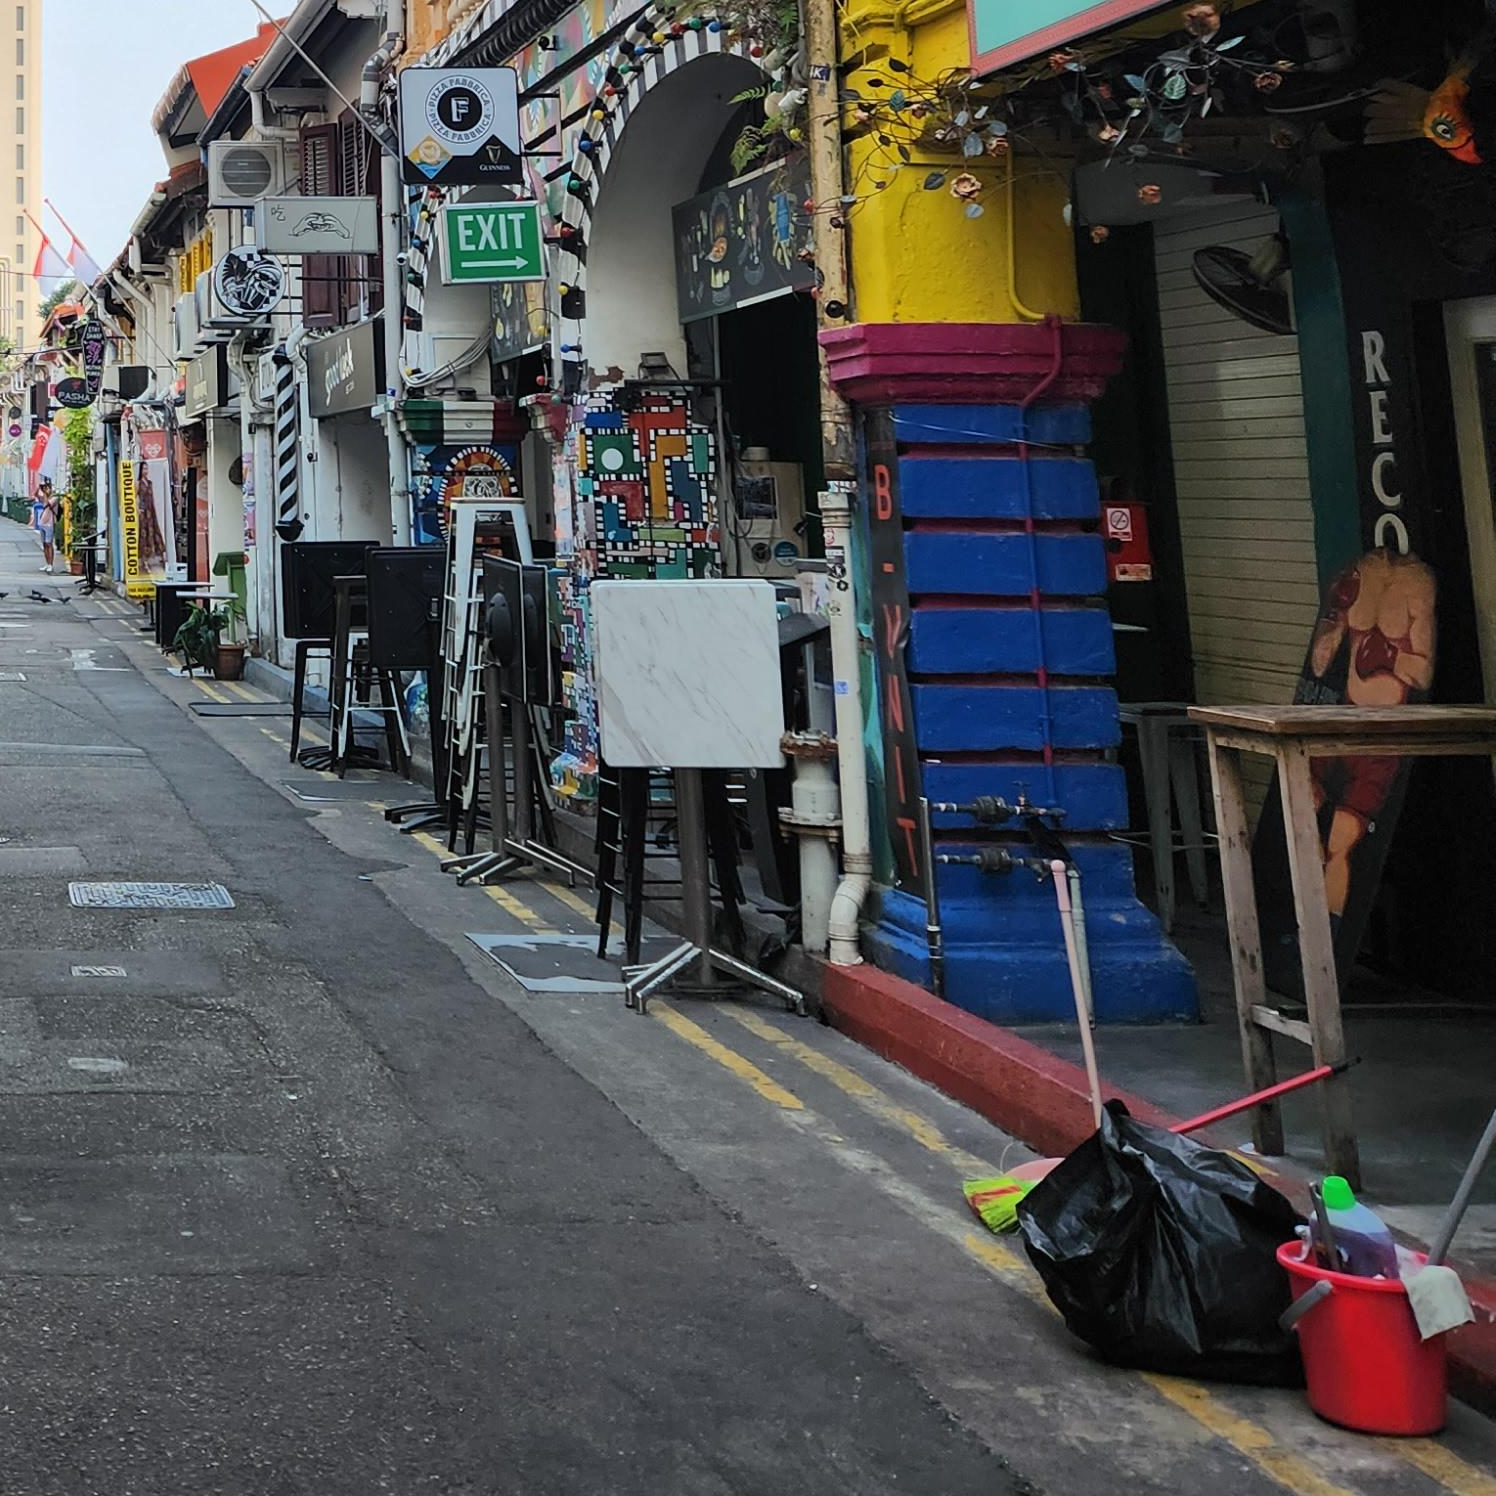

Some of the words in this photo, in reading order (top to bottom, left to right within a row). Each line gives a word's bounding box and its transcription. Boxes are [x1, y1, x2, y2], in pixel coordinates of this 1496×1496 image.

[428, 81, 448, 107] PIZZA
[457, 213, 526, 251] EXIT
[57, 391, 91, 402] PASHA
[122, 460, 135, 523] BOUTIQUE
[126, 527, 138, 576] COTTON
